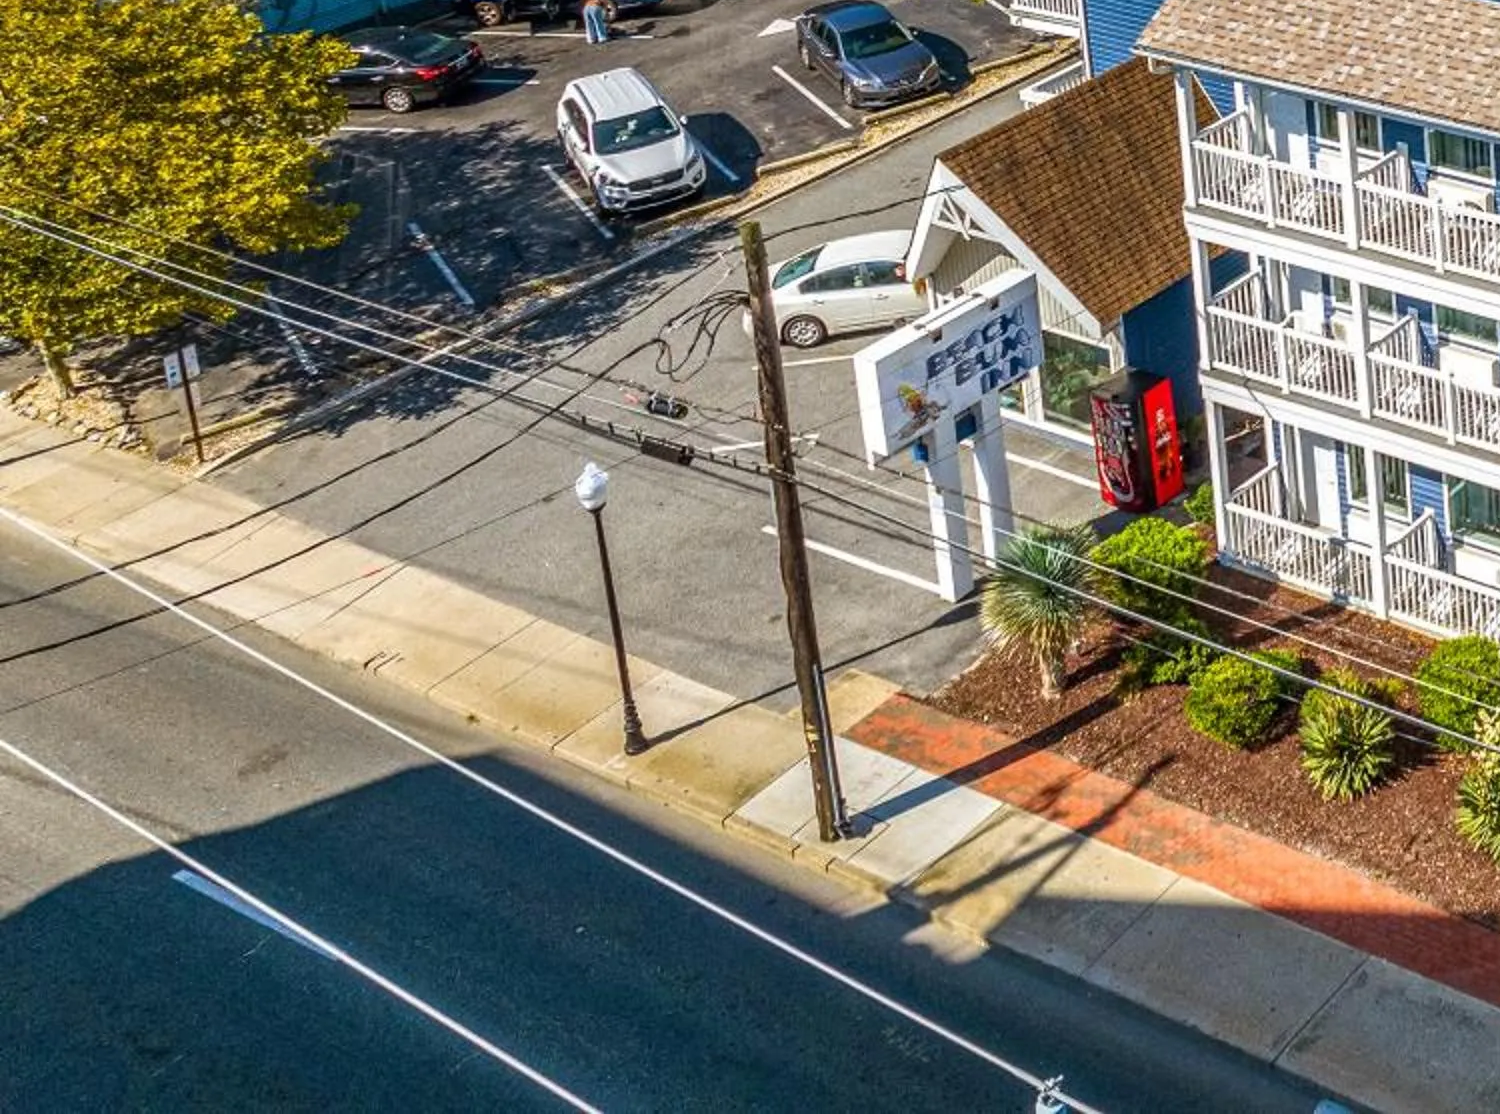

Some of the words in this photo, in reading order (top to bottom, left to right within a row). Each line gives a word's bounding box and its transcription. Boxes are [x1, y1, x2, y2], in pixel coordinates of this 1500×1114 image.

[926, 303, 1025, 380] BEACH
[955, 328, 1032, 386] BUM
[981, 347, 1033, 394] INN
